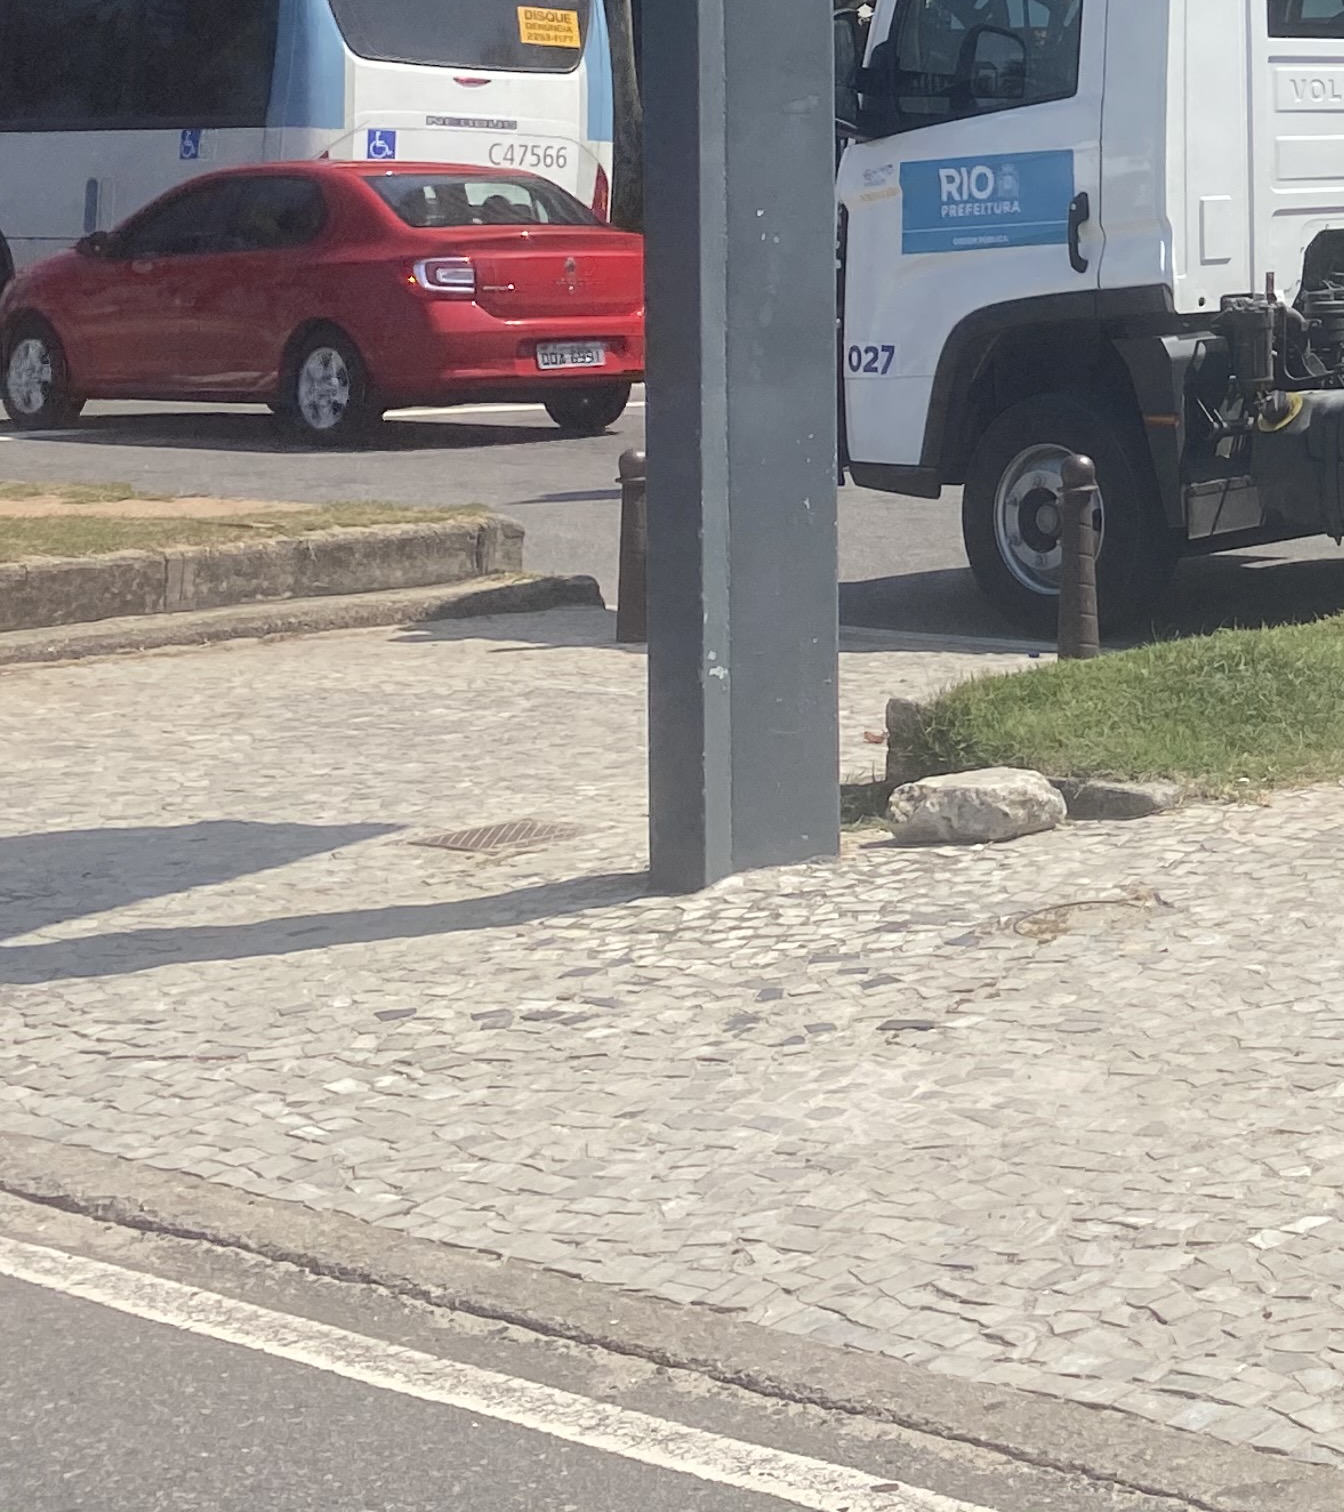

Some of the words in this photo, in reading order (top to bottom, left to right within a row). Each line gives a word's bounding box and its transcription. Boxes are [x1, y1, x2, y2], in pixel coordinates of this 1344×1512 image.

[524, 9, 572, 25] DISQUE
[488, 143, 568, 169] C47566
[938, 165, 995, 202] RIO
[940, 200, 1021, 218] PREFEITURA
[848, 344, 895, 375] 027
